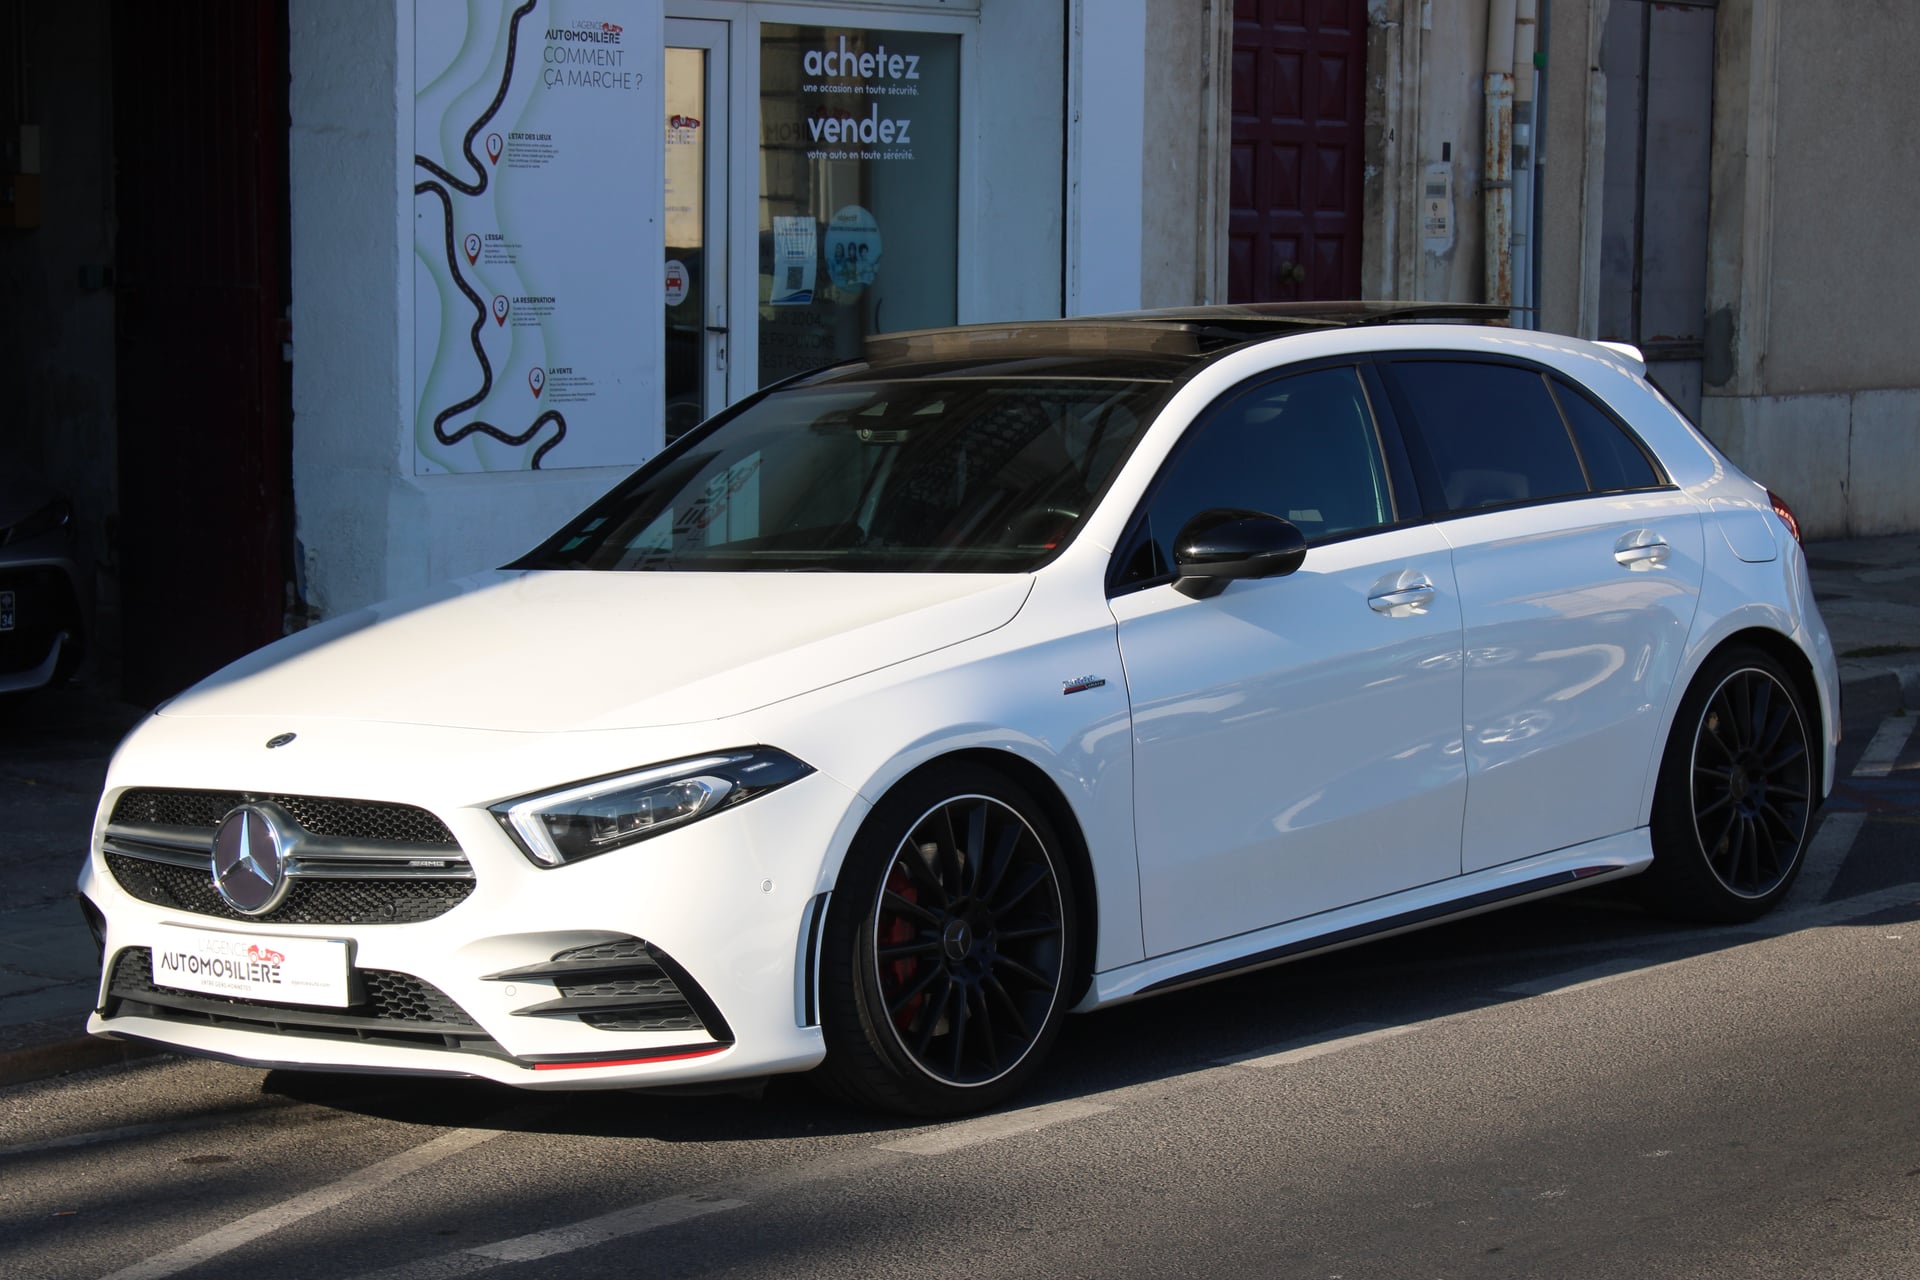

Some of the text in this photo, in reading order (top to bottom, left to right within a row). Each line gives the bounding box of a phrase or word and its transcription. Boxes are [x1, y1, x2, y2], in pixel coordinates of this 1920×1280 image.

[571, 20, 603, 30] L'AGENCE
[543, 46, 625, 67] COMMENT
[803, 35, 920, 80] achetez
[543, 68, 643, 90] ÇA MARCHE ?
[803, 83, 919, 96] une occasion en toute sécurité.
[807, 102, 911, 144] vendez
[807, 149, 915, 161] votre auto en toute sérénité.
[470, 239, 476, 251] 2
[498, 301, 504, 312] 3
[534, 373, 541, 385] 4
[1, 613, 13, 626] 34
[199, 938, 248, 957] L'AGENCE
